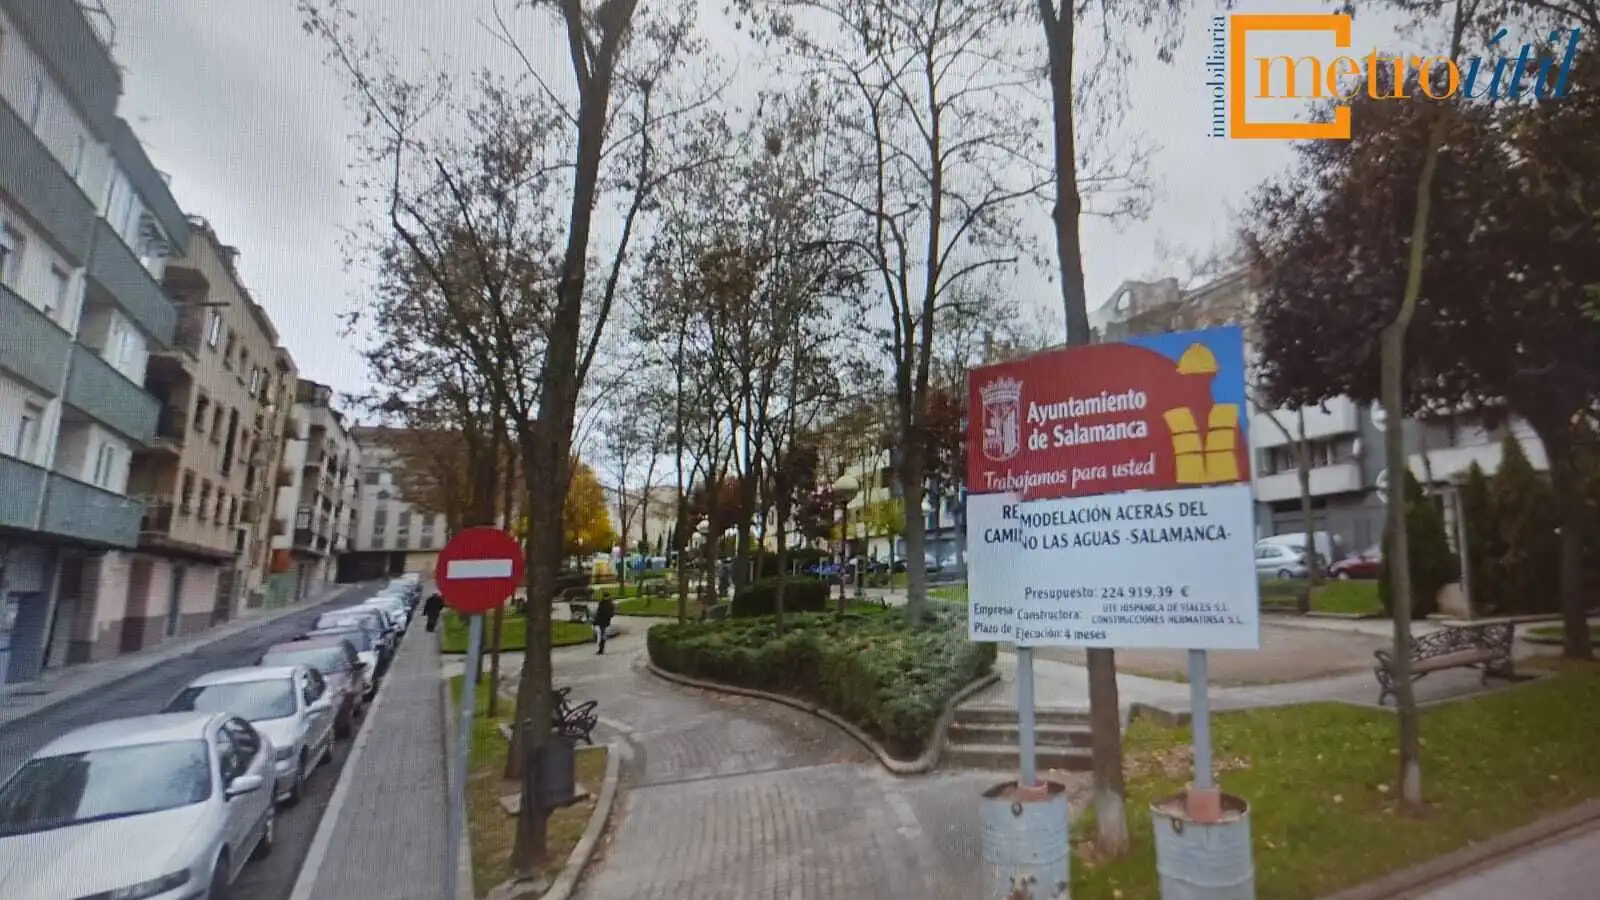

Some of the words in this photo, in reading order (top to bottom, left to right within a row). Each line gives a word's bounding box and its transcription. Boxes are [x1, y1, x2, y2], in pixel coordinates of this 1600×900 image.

[1027, 388, 1147, 426] Ayuntamiento
[1028, 427, 1049, 451] de
[1053, 419, 1148, 448] Salamanca
[983, 469, 1067, 493] Trabajamos
[1071, 466, 1107, 489] para
[1112, 453, 1155, 477] usted
[1116, 501, 1174, 521] ACERAS
[1178, 500, 1208, 518] DEL
[1042, 532, 1069, 549] LAS
[1073, 528, 1121, 548] AGUAS
[1024, 586, 1098, 601] Presupuesto:
[1180, 585, 1190, 598] €
[974, 622, 998, 634] Plazo
[1000, 623, 1012, 634] de
[1074, 629, 1107, 640] meses
